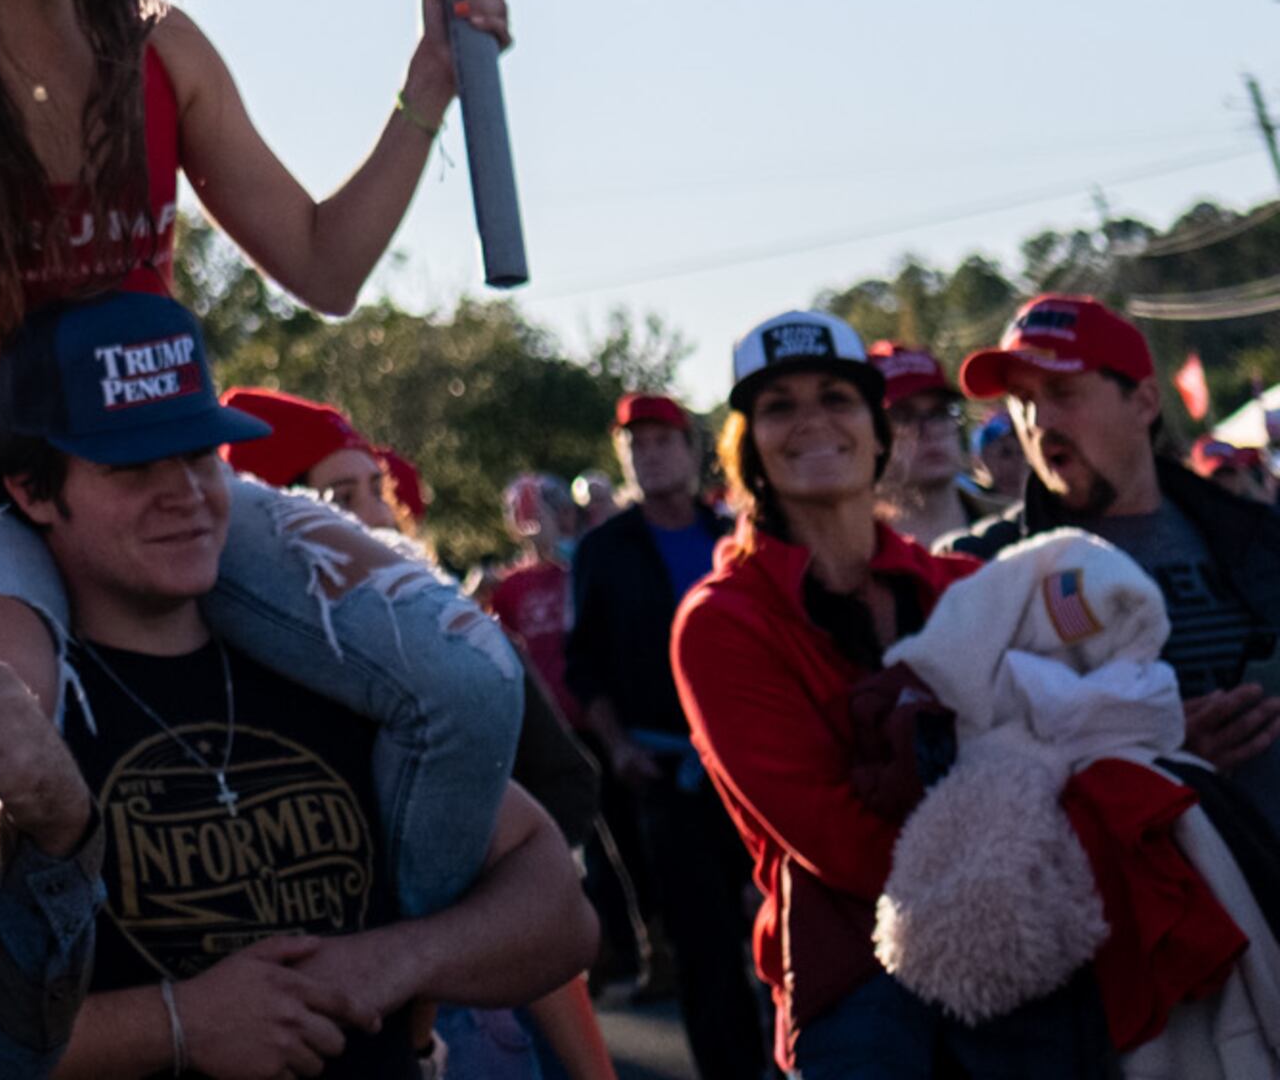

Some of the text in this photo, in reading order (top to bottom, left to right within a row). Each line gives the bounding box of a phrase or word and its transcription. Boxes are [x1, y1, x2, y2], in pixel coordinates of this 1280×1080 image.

[94, 336, 195, 381] TRUMP
[100, 372, 181, 407] PENCE
[110, 793, 362, 917] INFORMED
[243, 868, 345, 928] WHEN
